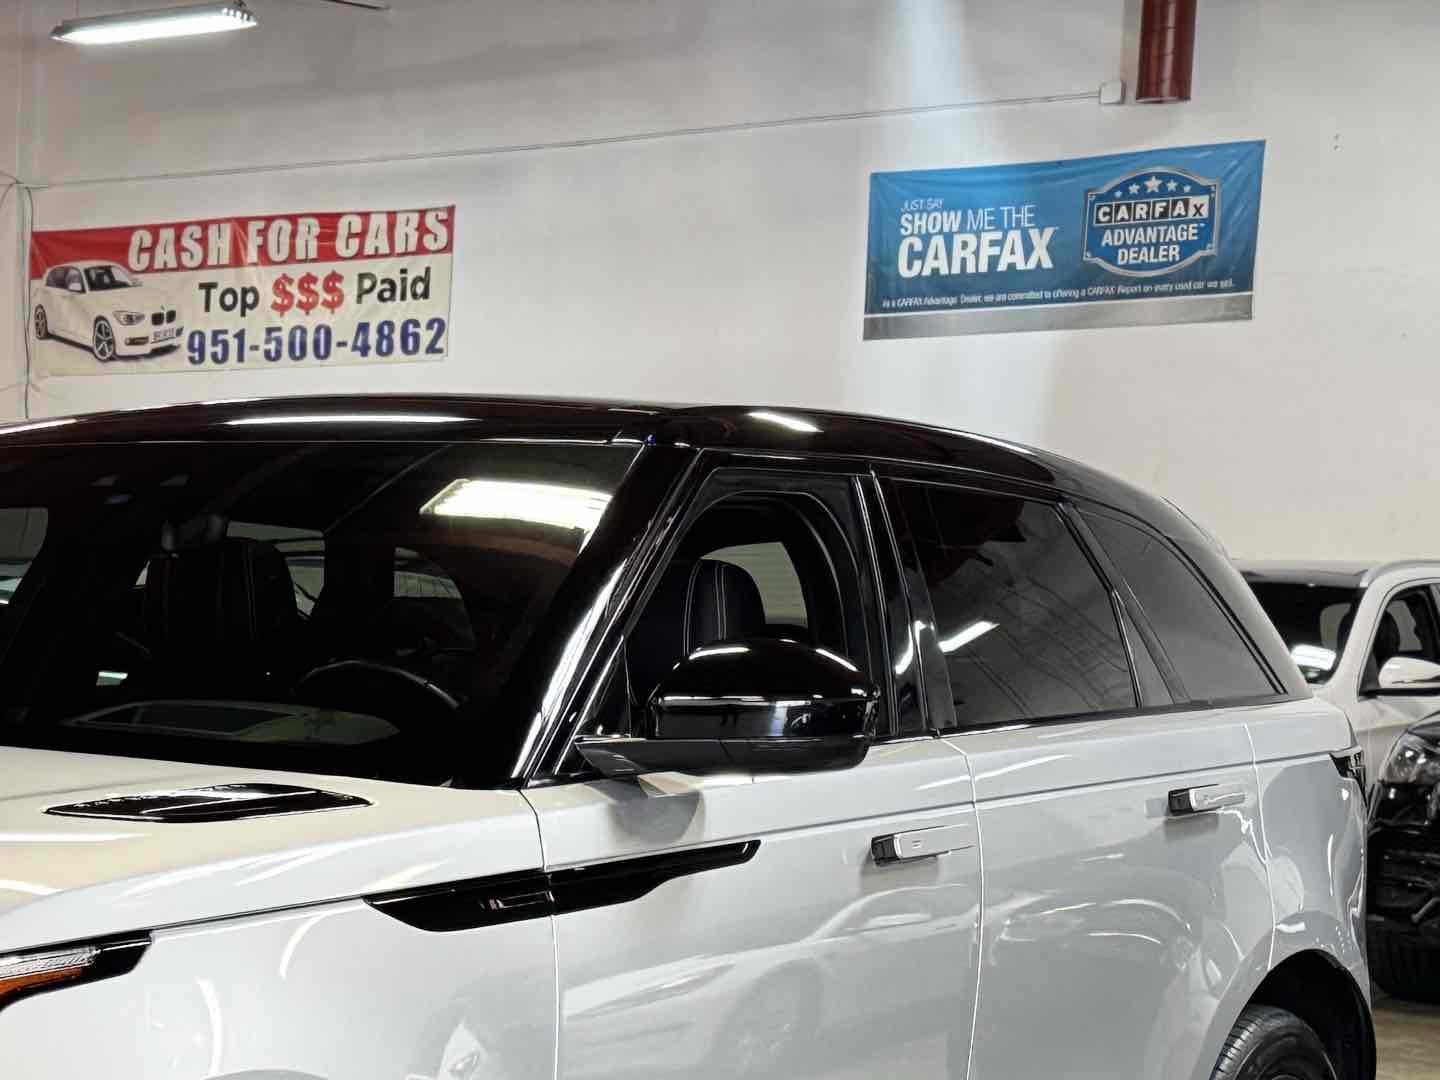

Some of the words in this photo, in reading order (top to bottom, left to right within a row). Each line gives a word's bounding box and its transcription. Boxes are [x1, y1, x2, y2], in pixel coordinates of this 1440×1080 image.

[900, 210, 962, 235] SHOW
[967, 208, 997, 231] ME
[1000, 204, 1037, 229] THE
[1097, 200, 1205, 223] CARFAX
[127, 223, 231, 272] CASH
[246, 214, 321, 265] FOR
[335, 208, 449, 258] CARS
[898, 227, 1056, 278] CARFAX
[1101, 224, 1199, 248] ADVANTAGE
[1117, 245, 1181, 266] DEALER
[198, 281, 259, 316] Top
[271, 271, 344, 316] $$$
[356, 267, 430, 304] Paid
[187, 318, 447, 366] 951-500-4862
